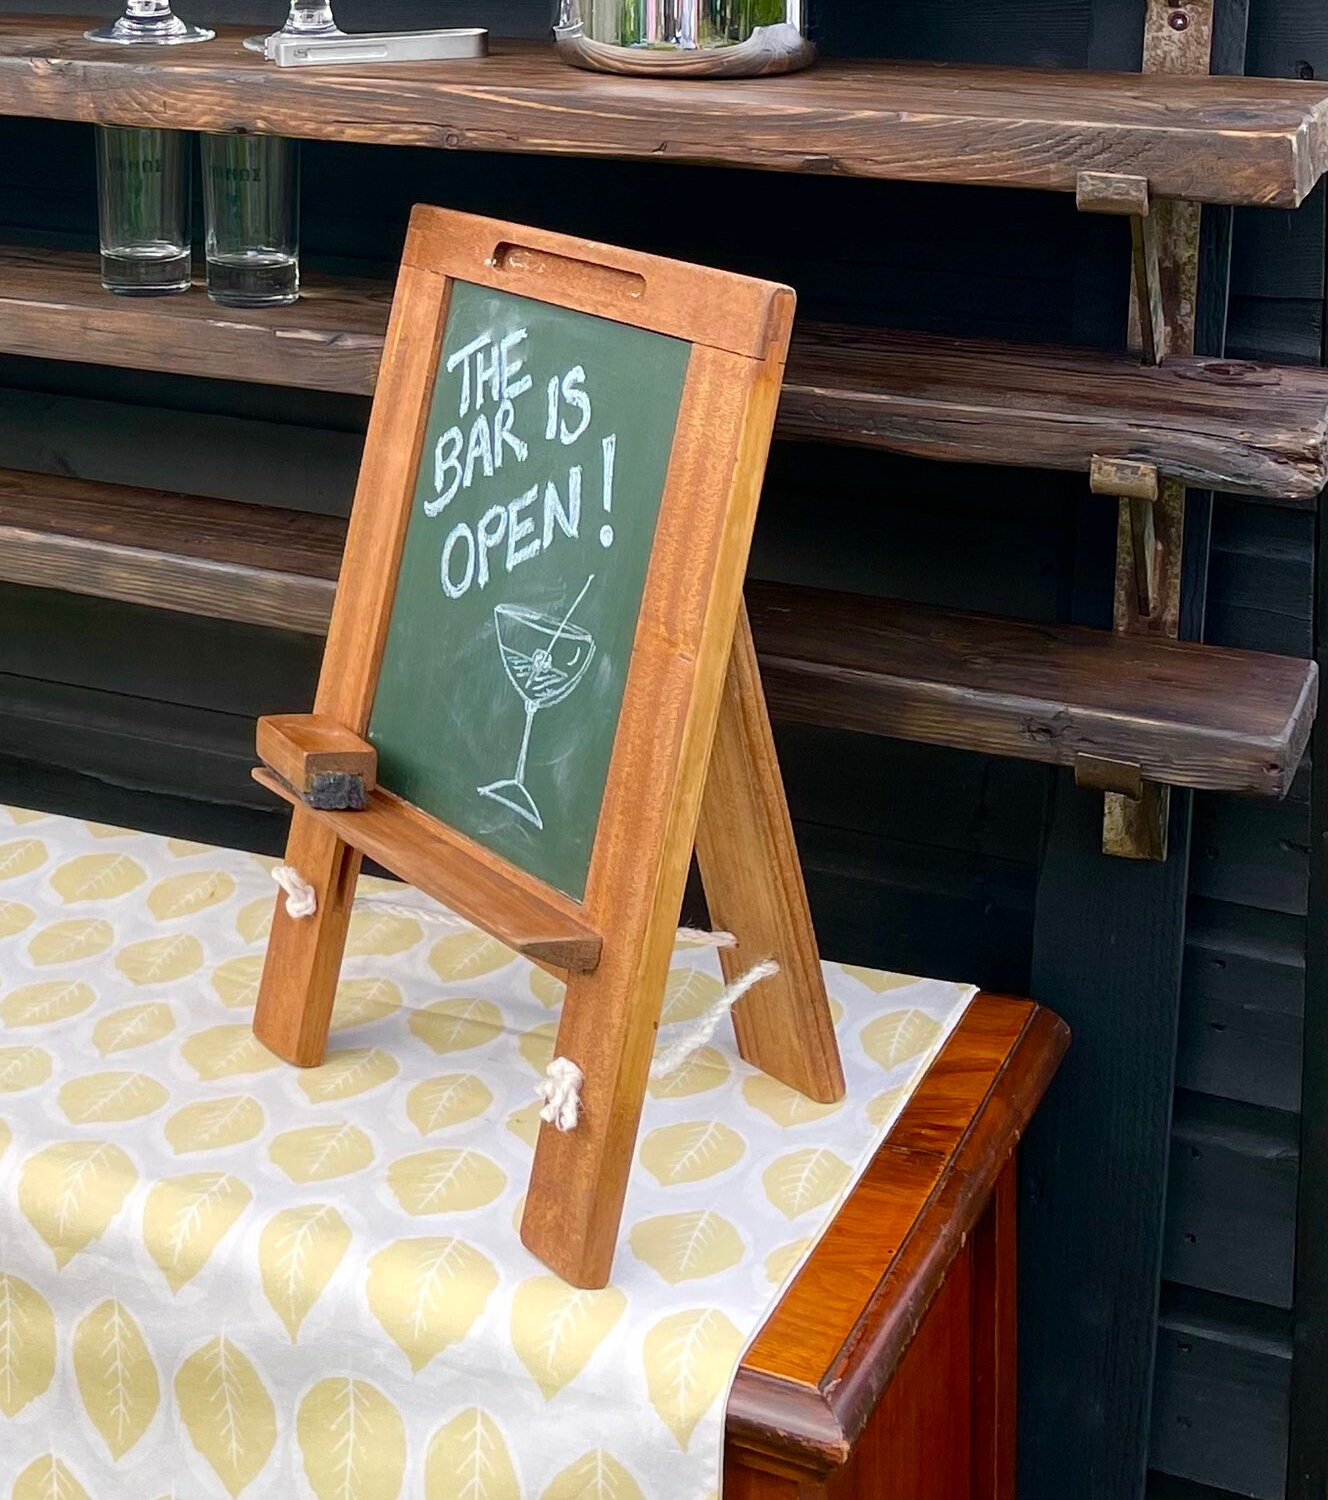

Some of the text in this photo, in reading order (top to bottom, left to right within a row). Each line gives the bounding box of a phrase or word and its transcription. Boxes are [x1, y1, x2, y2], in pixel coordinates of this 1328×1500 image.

[446, 328, 533, 418] THE
[424, 364, 591, 518] BAR IS
